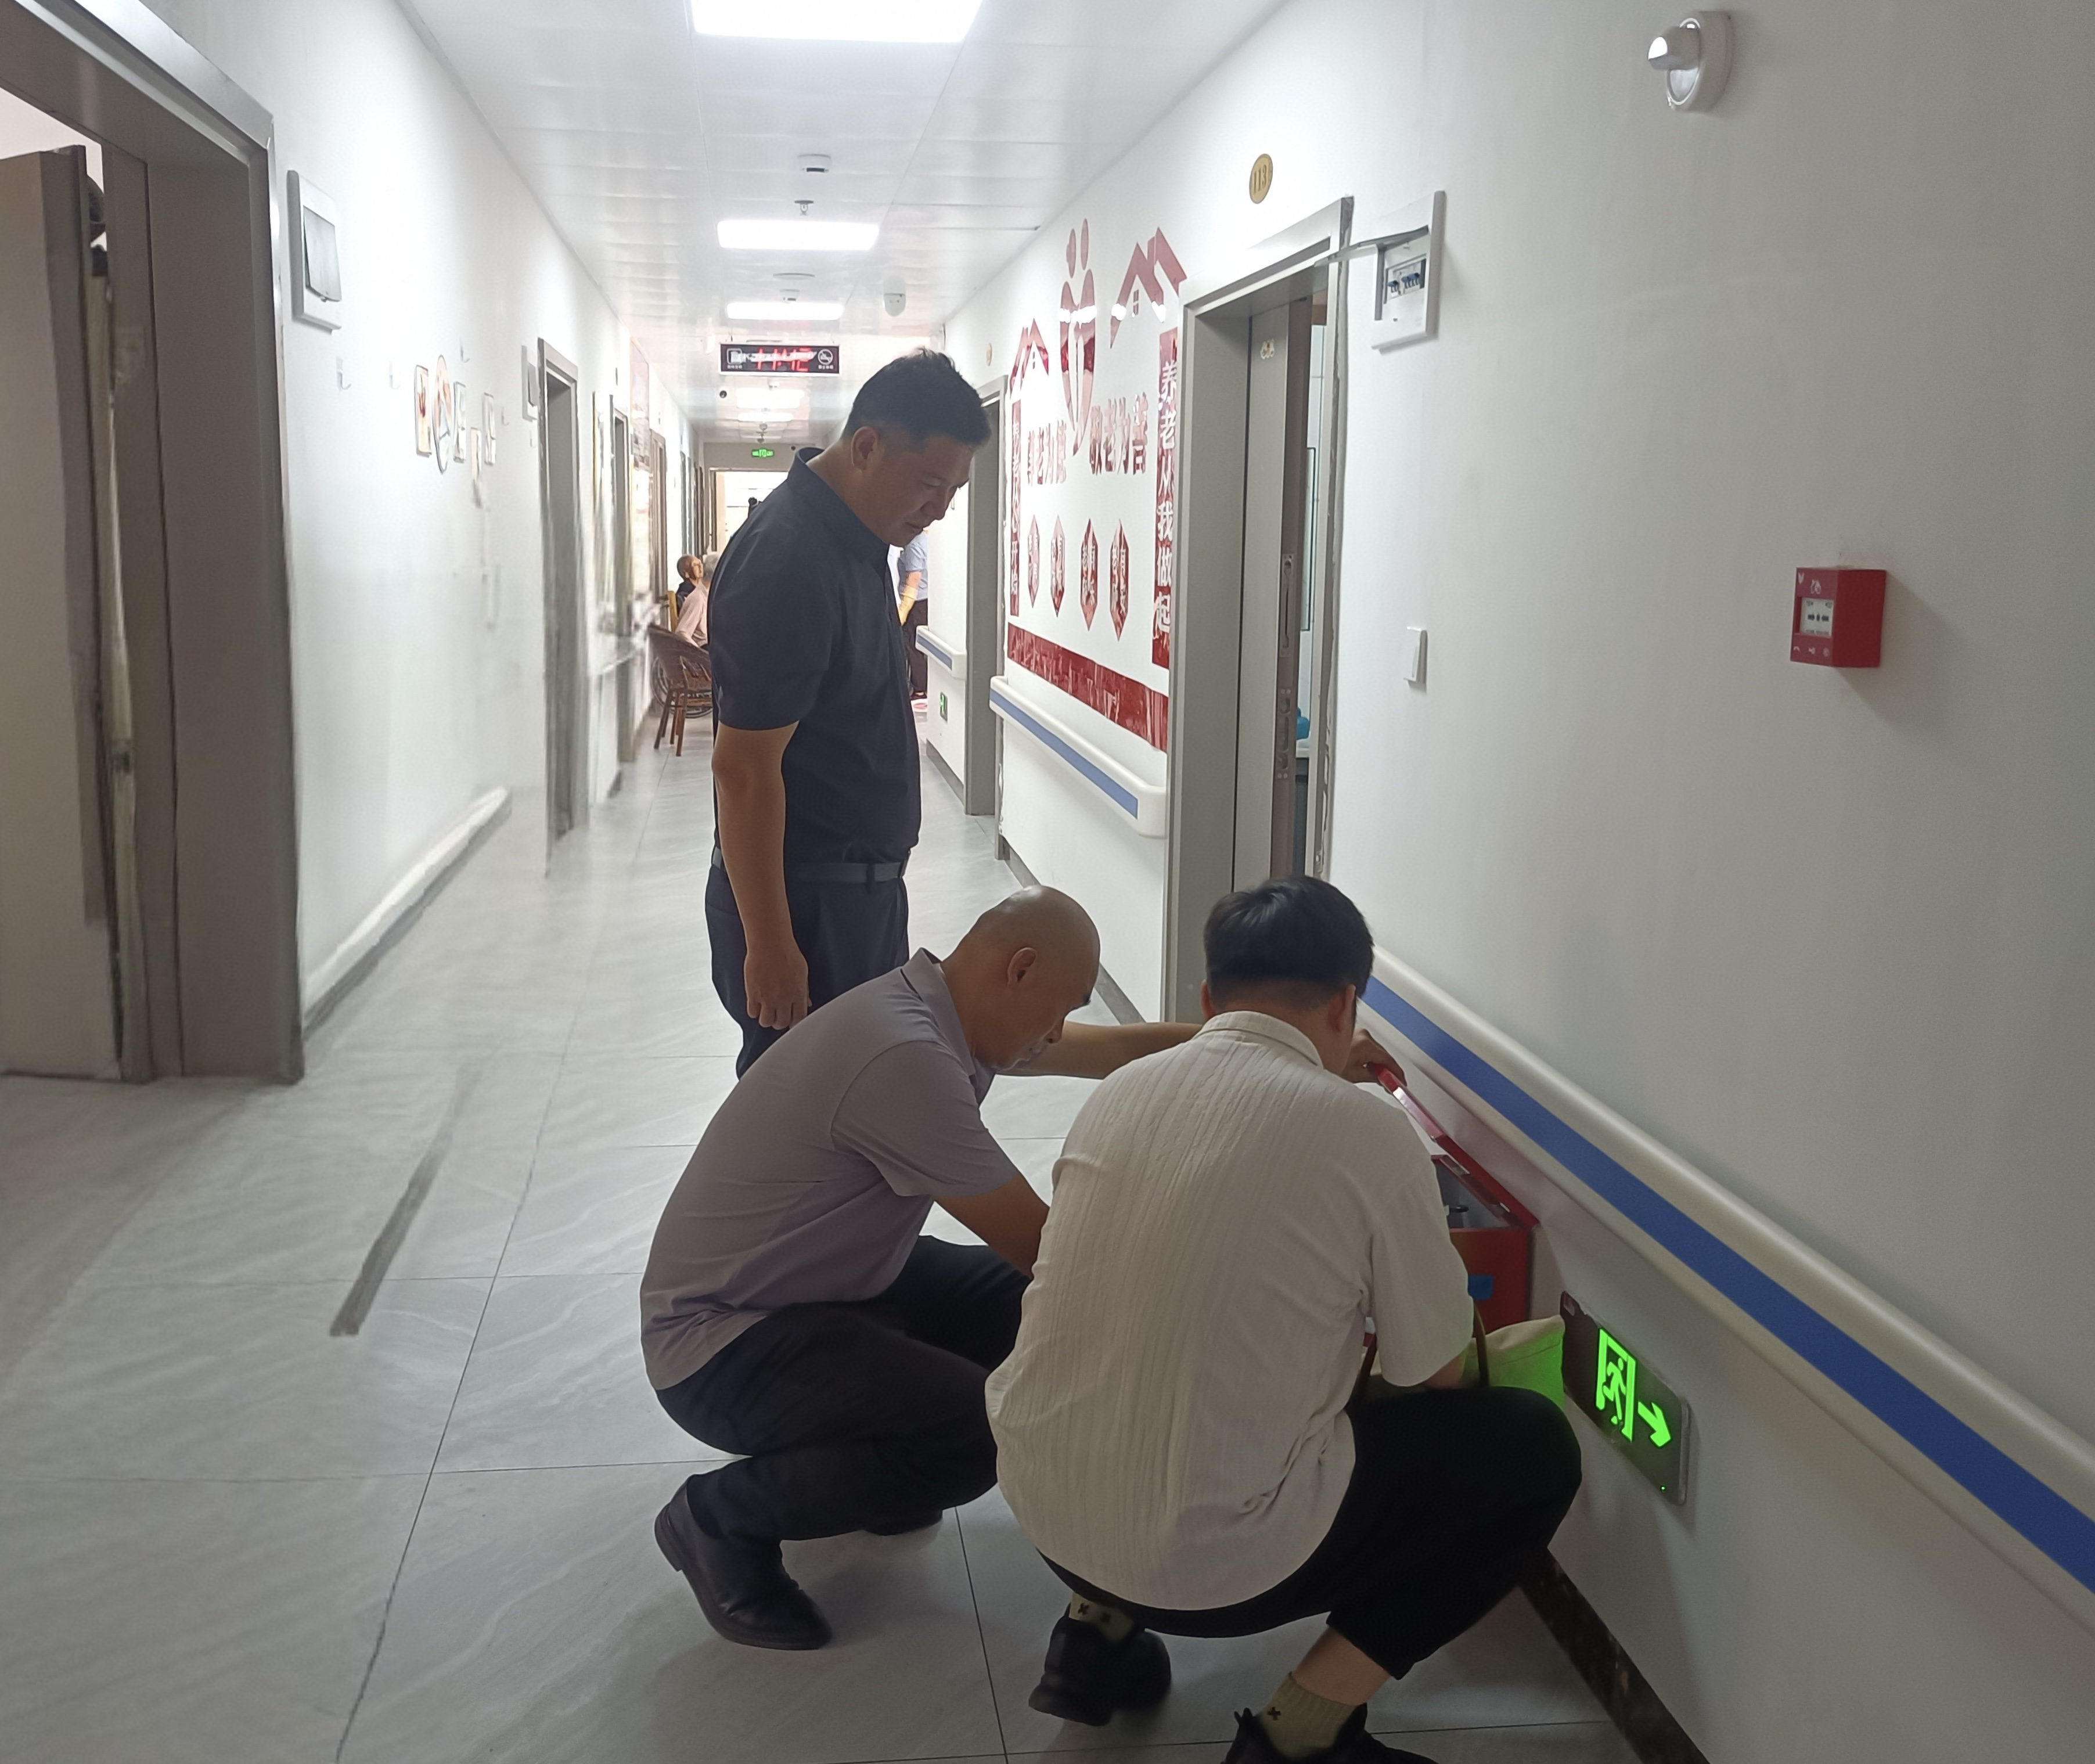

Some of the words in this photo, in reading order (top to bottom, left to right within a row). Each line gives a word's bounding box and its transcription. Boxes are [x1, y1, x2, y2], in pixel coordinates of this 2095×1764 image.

[1253, 164, 1268, 194] 113
[1156, 359, 1178, 634] 养老从我做起
